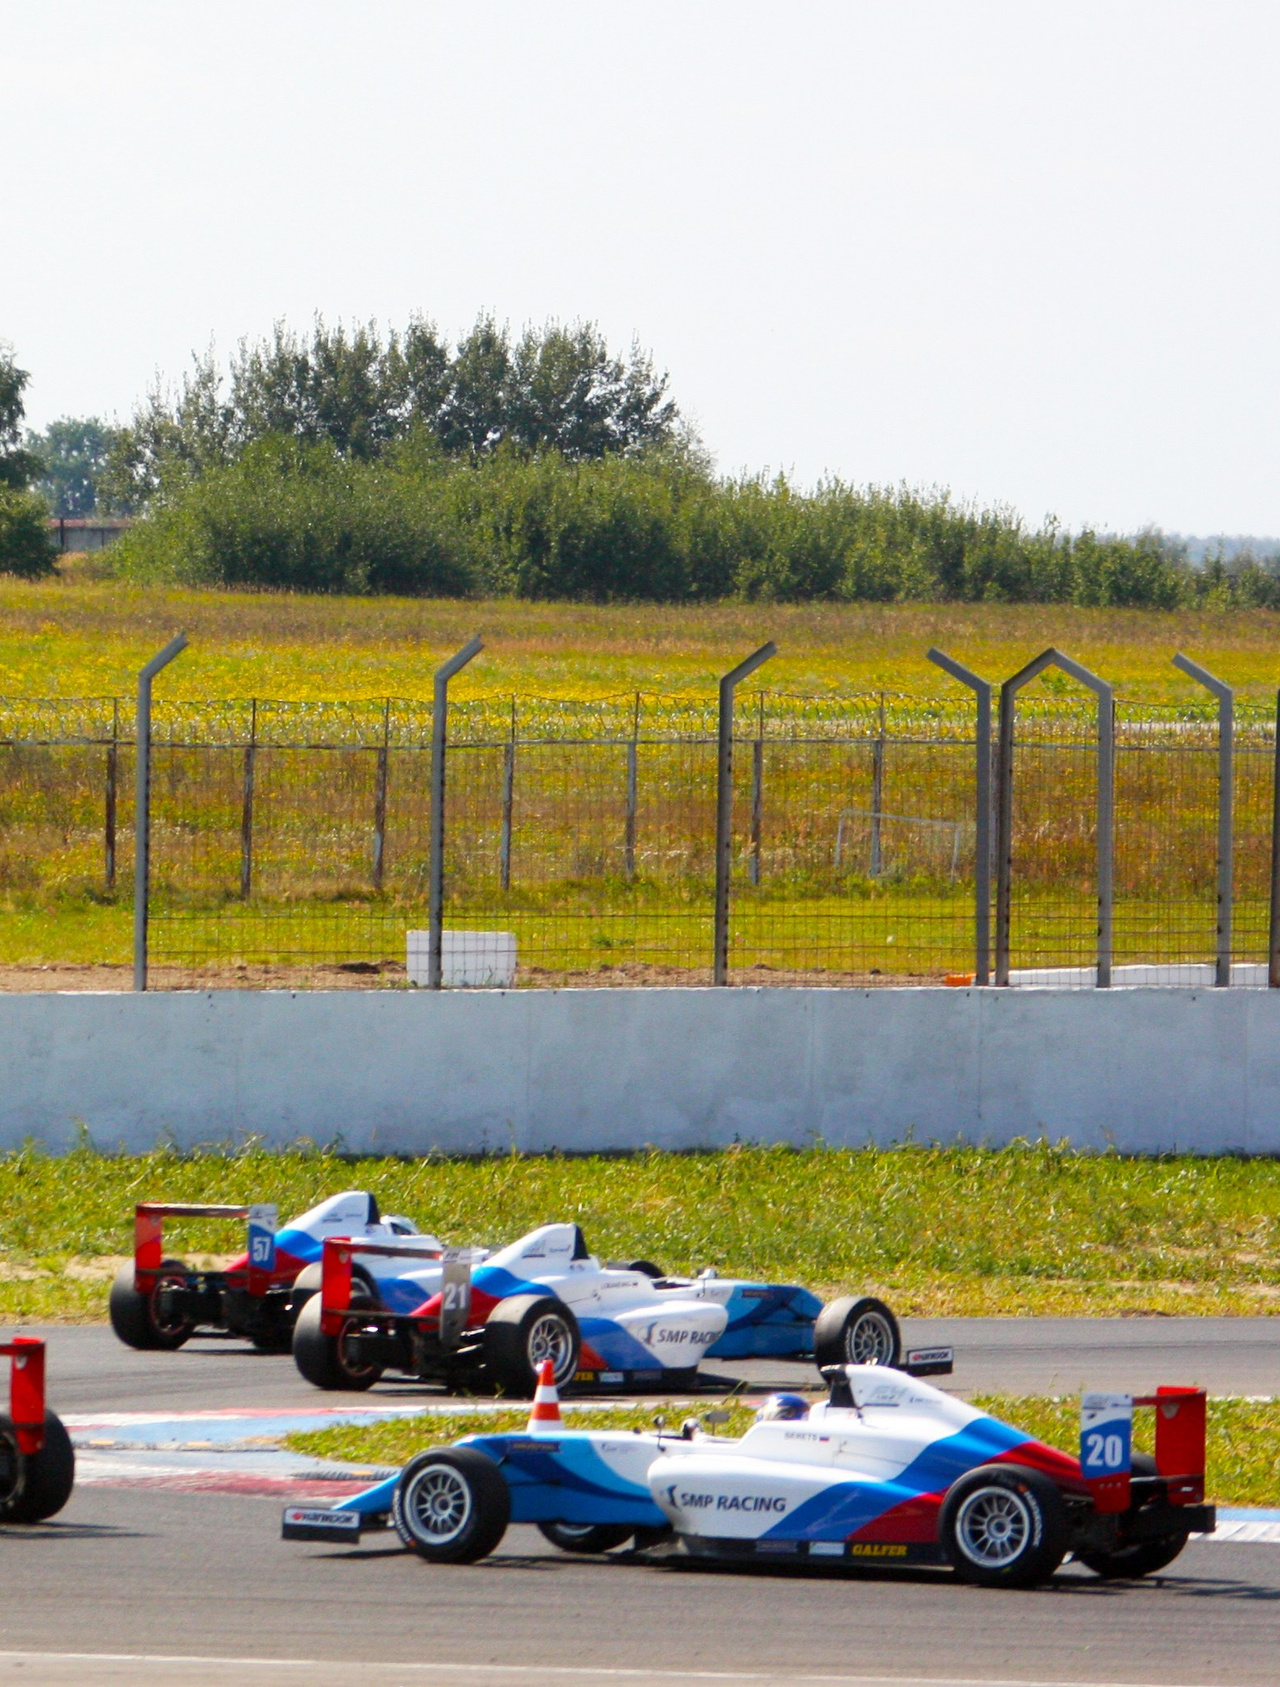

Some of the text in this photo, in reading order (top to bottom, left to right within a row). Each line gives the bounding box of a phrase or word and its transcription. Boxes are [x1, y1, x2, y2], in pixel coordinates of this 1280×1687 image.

[253, 1236, 271, 1262] 57
[444, 1282, 466, 1310] 21
[657, 1328, 689, 1344] SMP
[1086, 1433, 1123, 1468] 20
[680, 1492, 787, 1513] SMP RACING
[851, 1543, 908, 1557] GALFER
